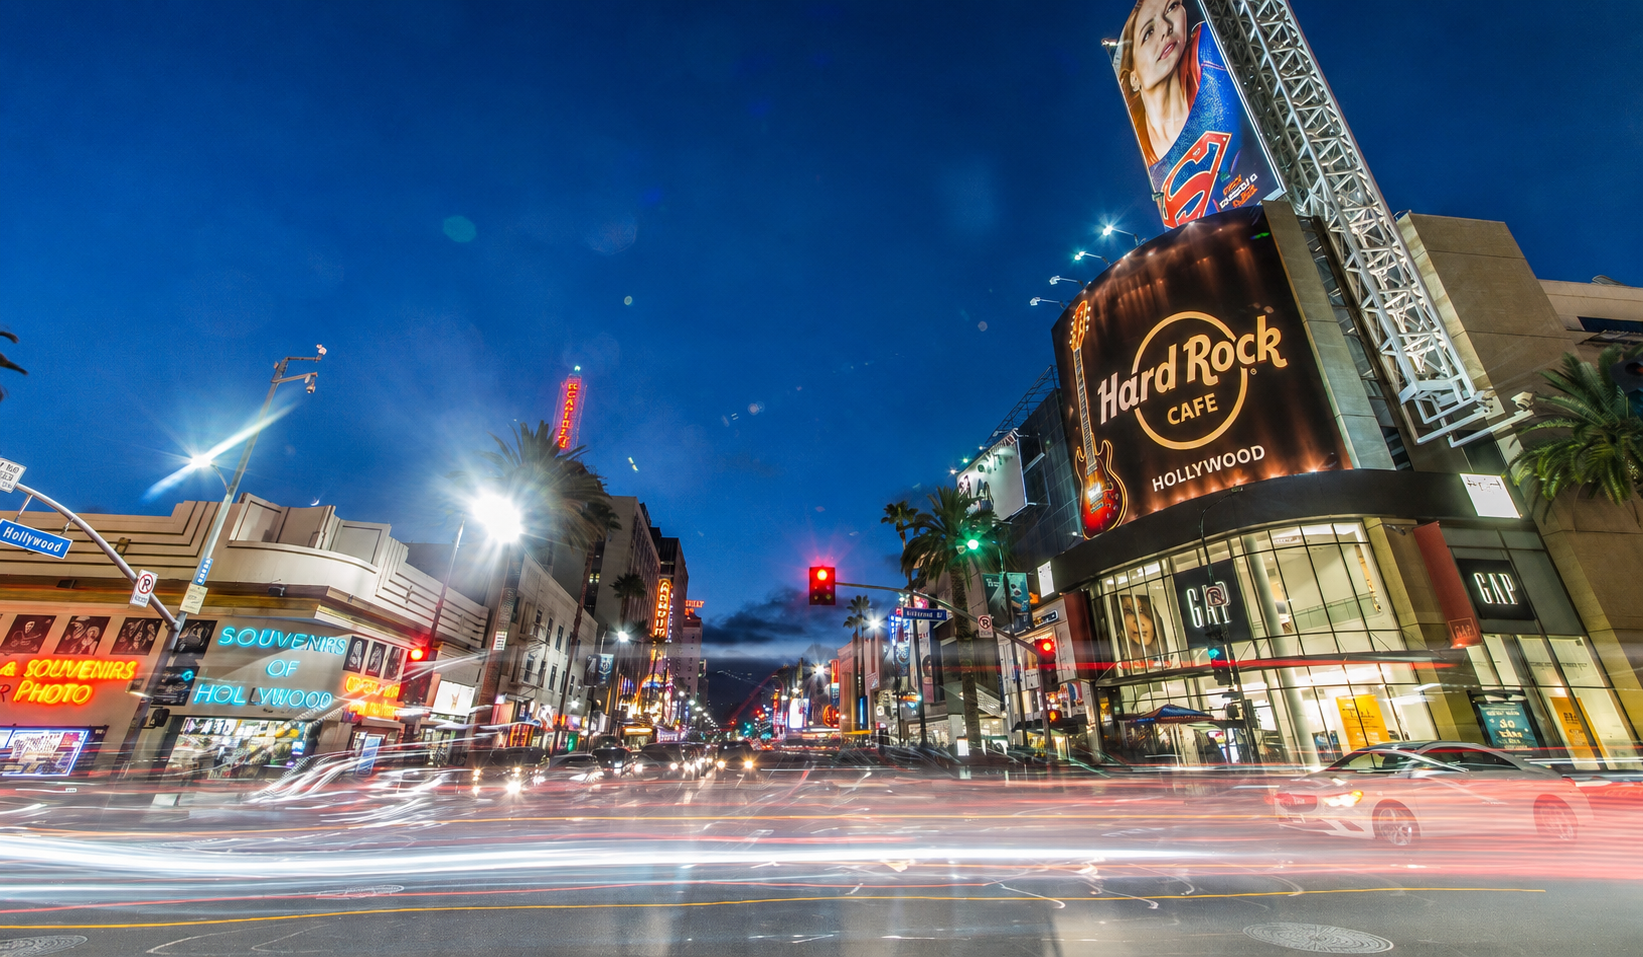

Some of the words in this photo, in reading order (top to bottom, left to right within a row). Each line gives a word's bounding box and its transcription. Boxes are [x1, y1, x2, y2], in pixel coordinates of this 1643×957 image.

[1097, 343, 1177, 425] Hard
[1182, 315, 1288, 387] Rock
[1167, 393, 1218, 425] CAFE
[1152, 444, 1266, 492] HOLLYWOOD
[3, 526, 63, 553] Hollywood
[1474, 572, 1519, 605] GAP
[218, 626, 347, 655] SOUVENIRS
[23, 659, 138, 680] SOUVENIRS
[266, 659, 300, 678] OF
[13, 680, 93, 704] PHOTO
[194, 684, 333, 709] HOLLYWOOD
